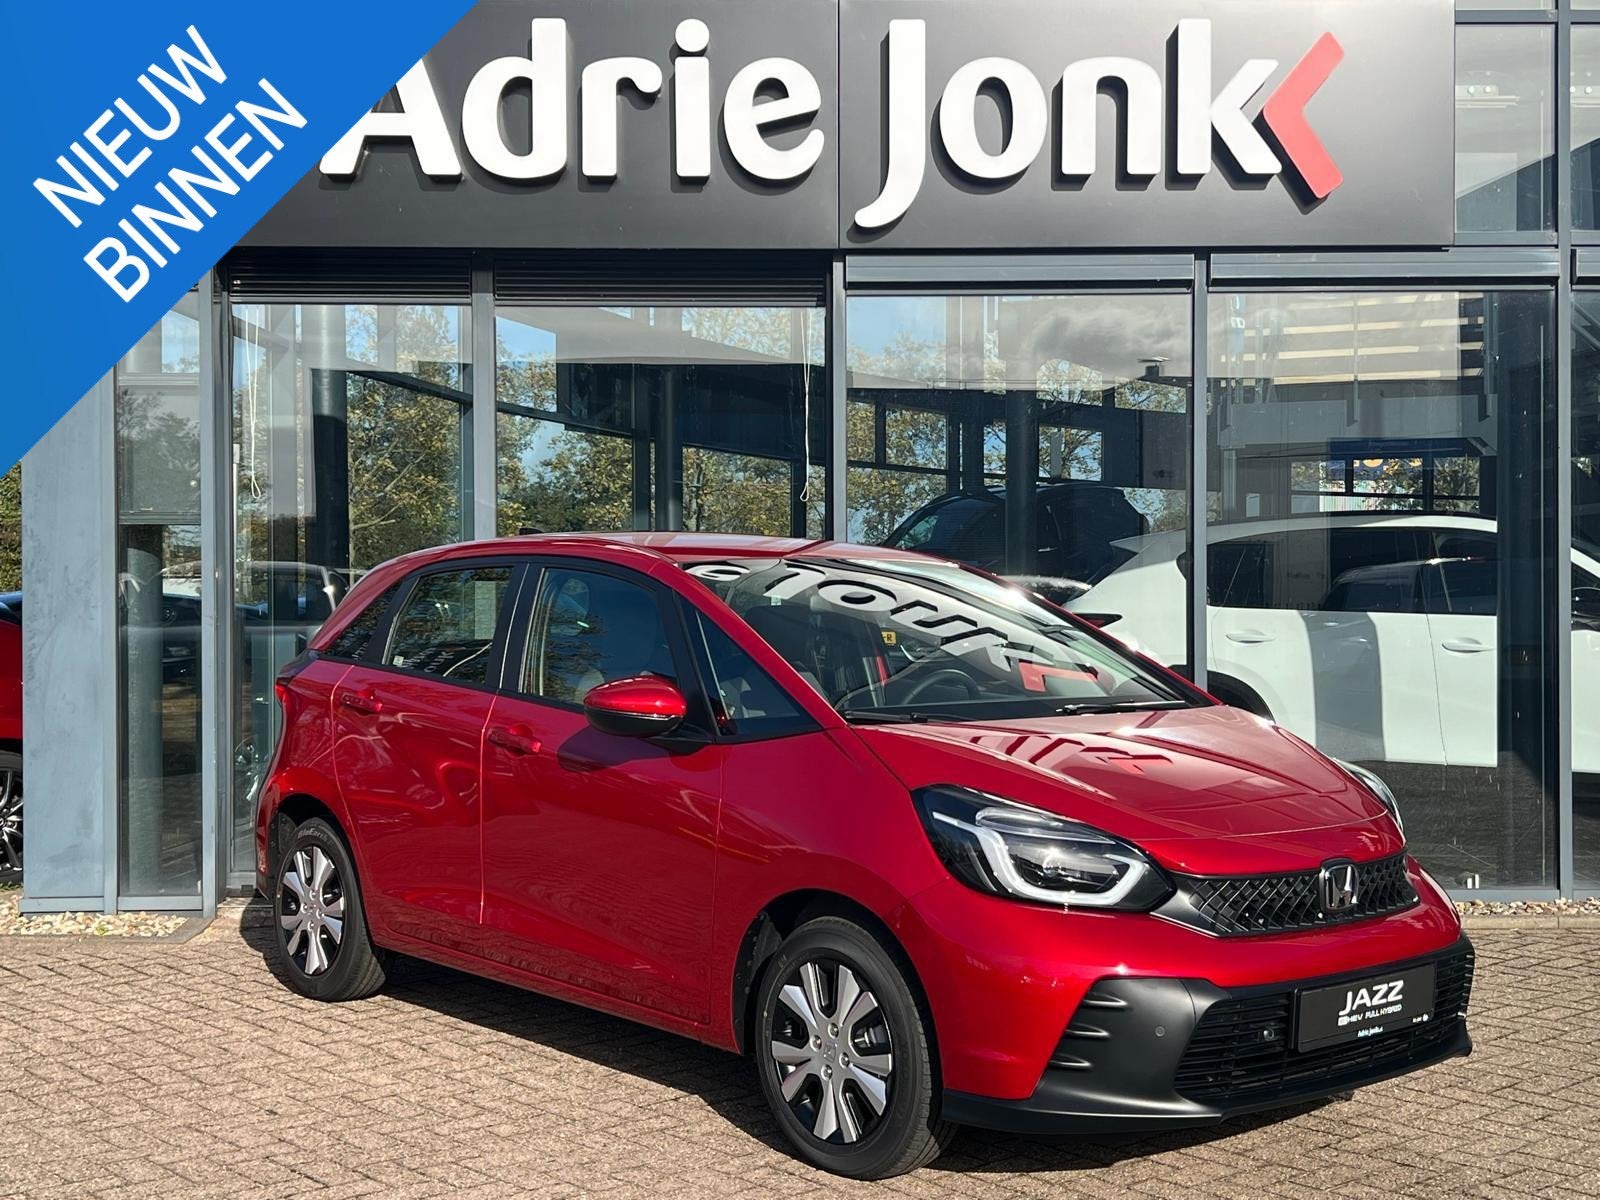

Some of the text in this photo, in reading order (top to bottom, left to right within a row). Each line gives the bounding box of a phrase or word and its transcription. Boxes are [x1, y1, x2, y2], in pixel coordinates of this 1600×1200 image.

[319, 18, 1282, 228] Adrie Jonk
[1338, 979, 1404, 1016] JAZZ
